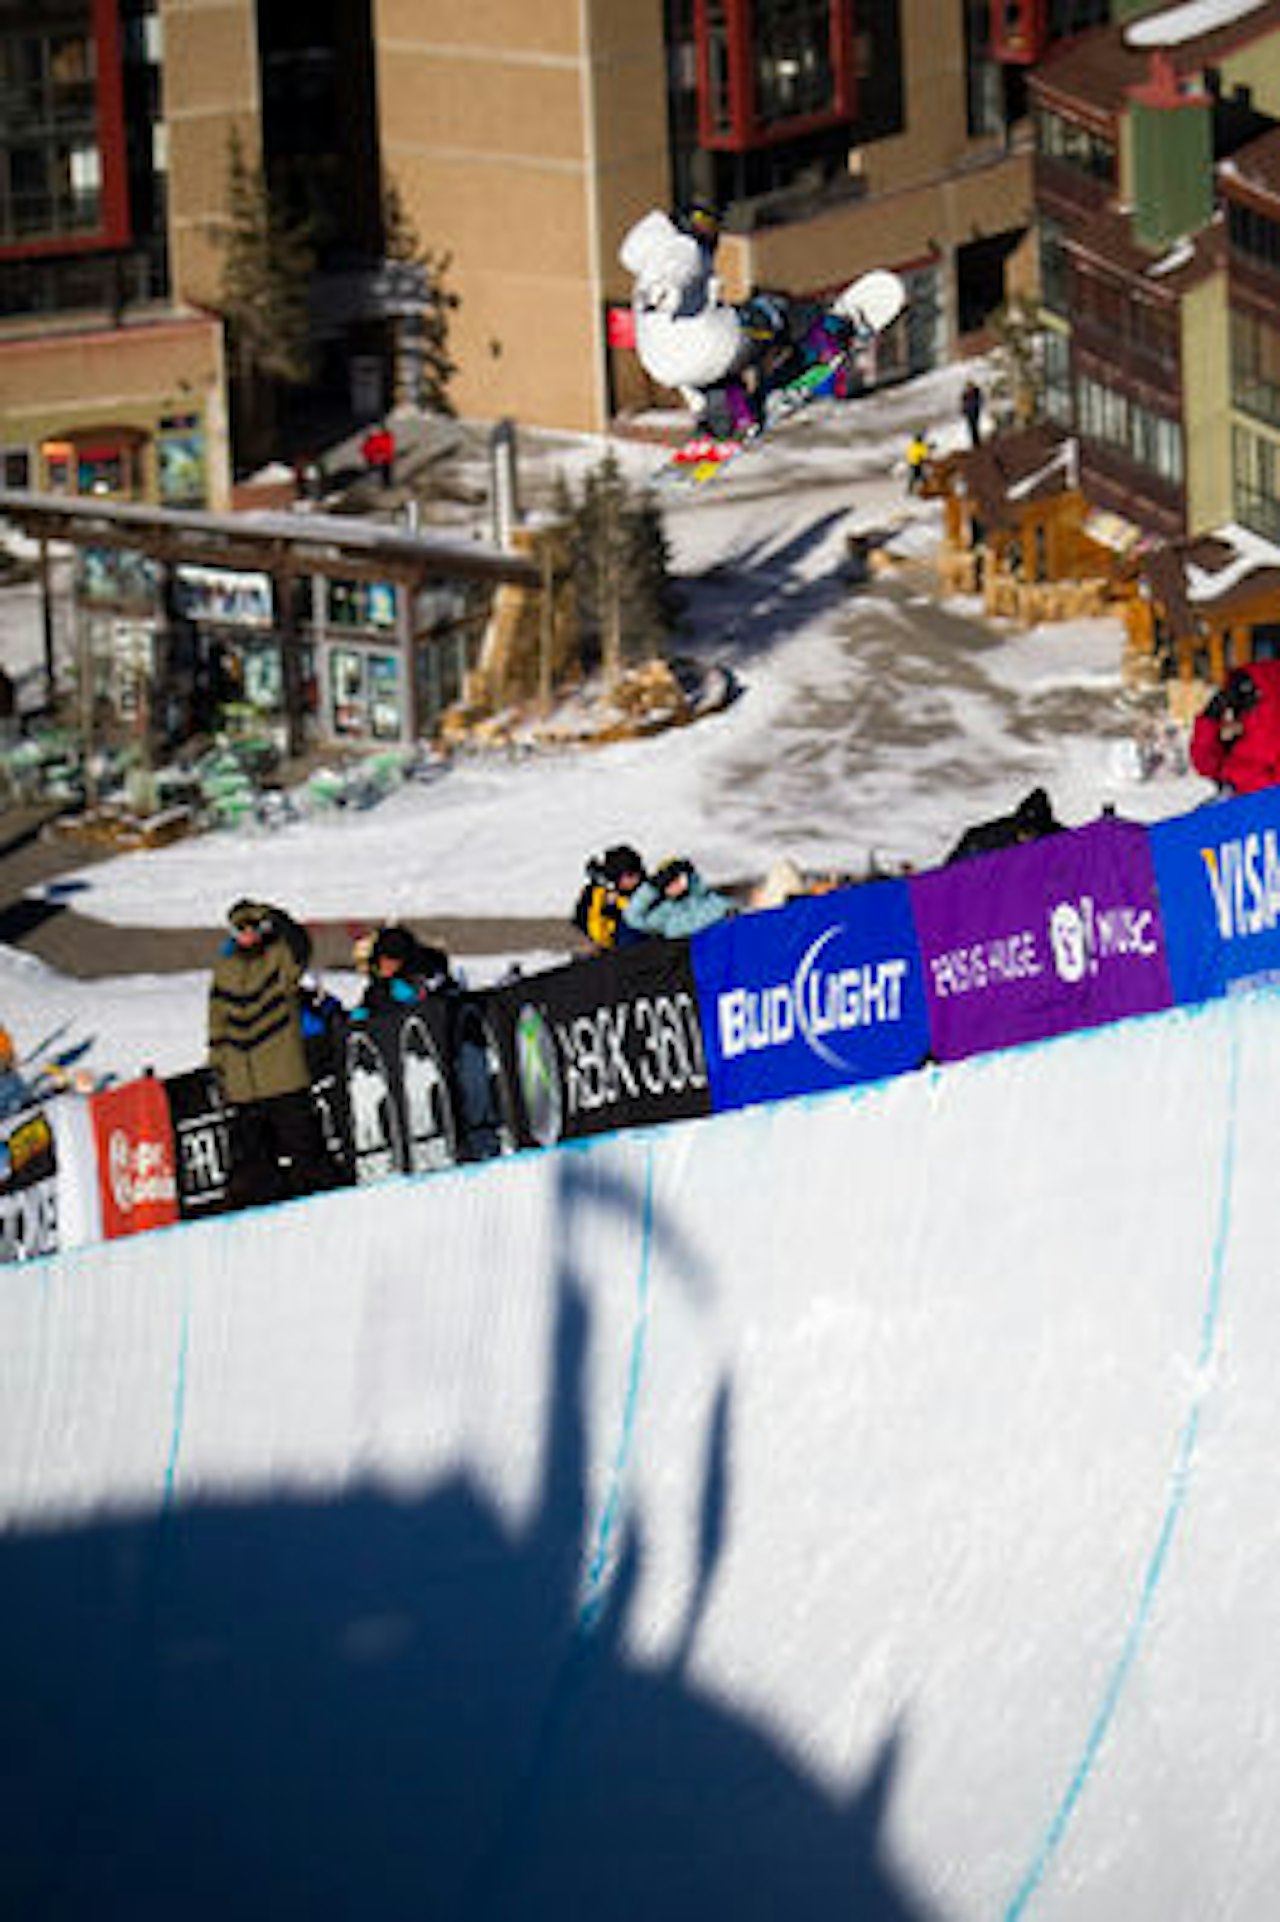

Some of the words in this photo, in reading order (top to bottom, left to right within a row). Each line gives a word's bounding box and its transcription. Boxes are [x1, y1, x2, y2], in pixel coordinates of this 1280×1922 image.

[1201, 828, 1280, 940] VISA
[635, 992, 708, 1096] 360
[718, 984, 794, 1060] BUD
[810, 959, 908, 1036] LIGHT
